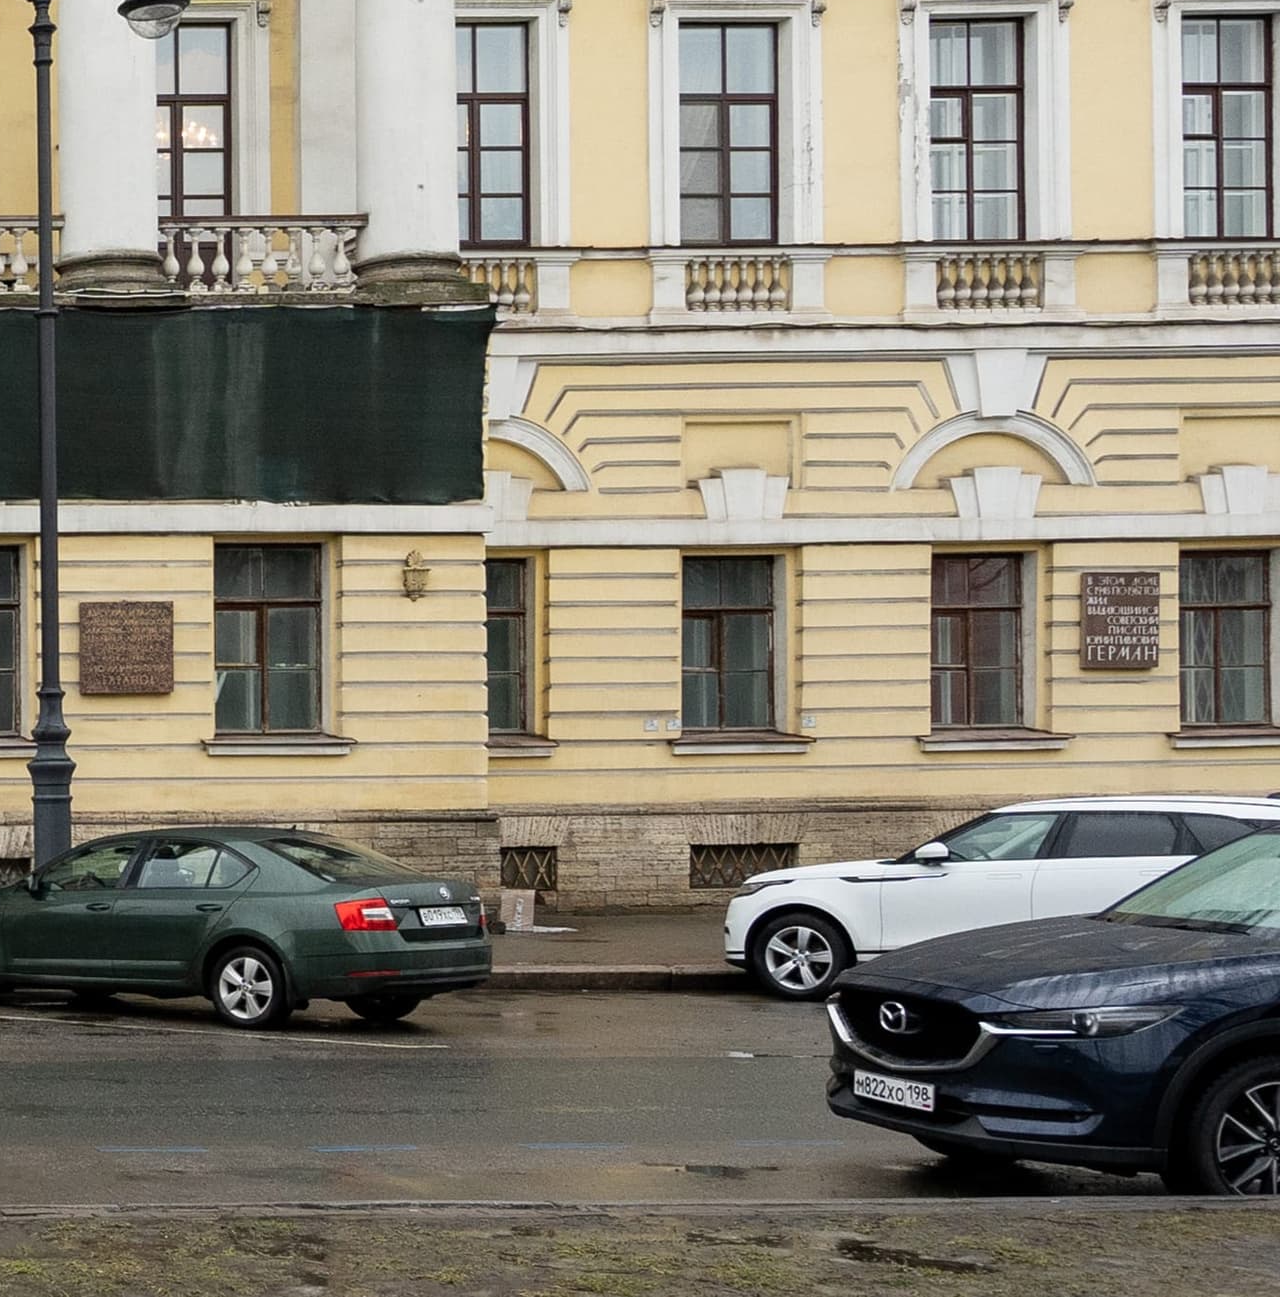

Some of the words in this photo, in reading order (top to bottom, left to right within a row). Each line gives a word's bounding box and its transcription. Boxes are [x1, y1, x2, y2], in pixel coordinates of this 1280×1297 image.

[1108, 625, 1158, 634] ПИСАТЕЛЬ
[1087, 645, 1157, 661] ГЕРМАН
[907, 1084, 930, 1102] 198
